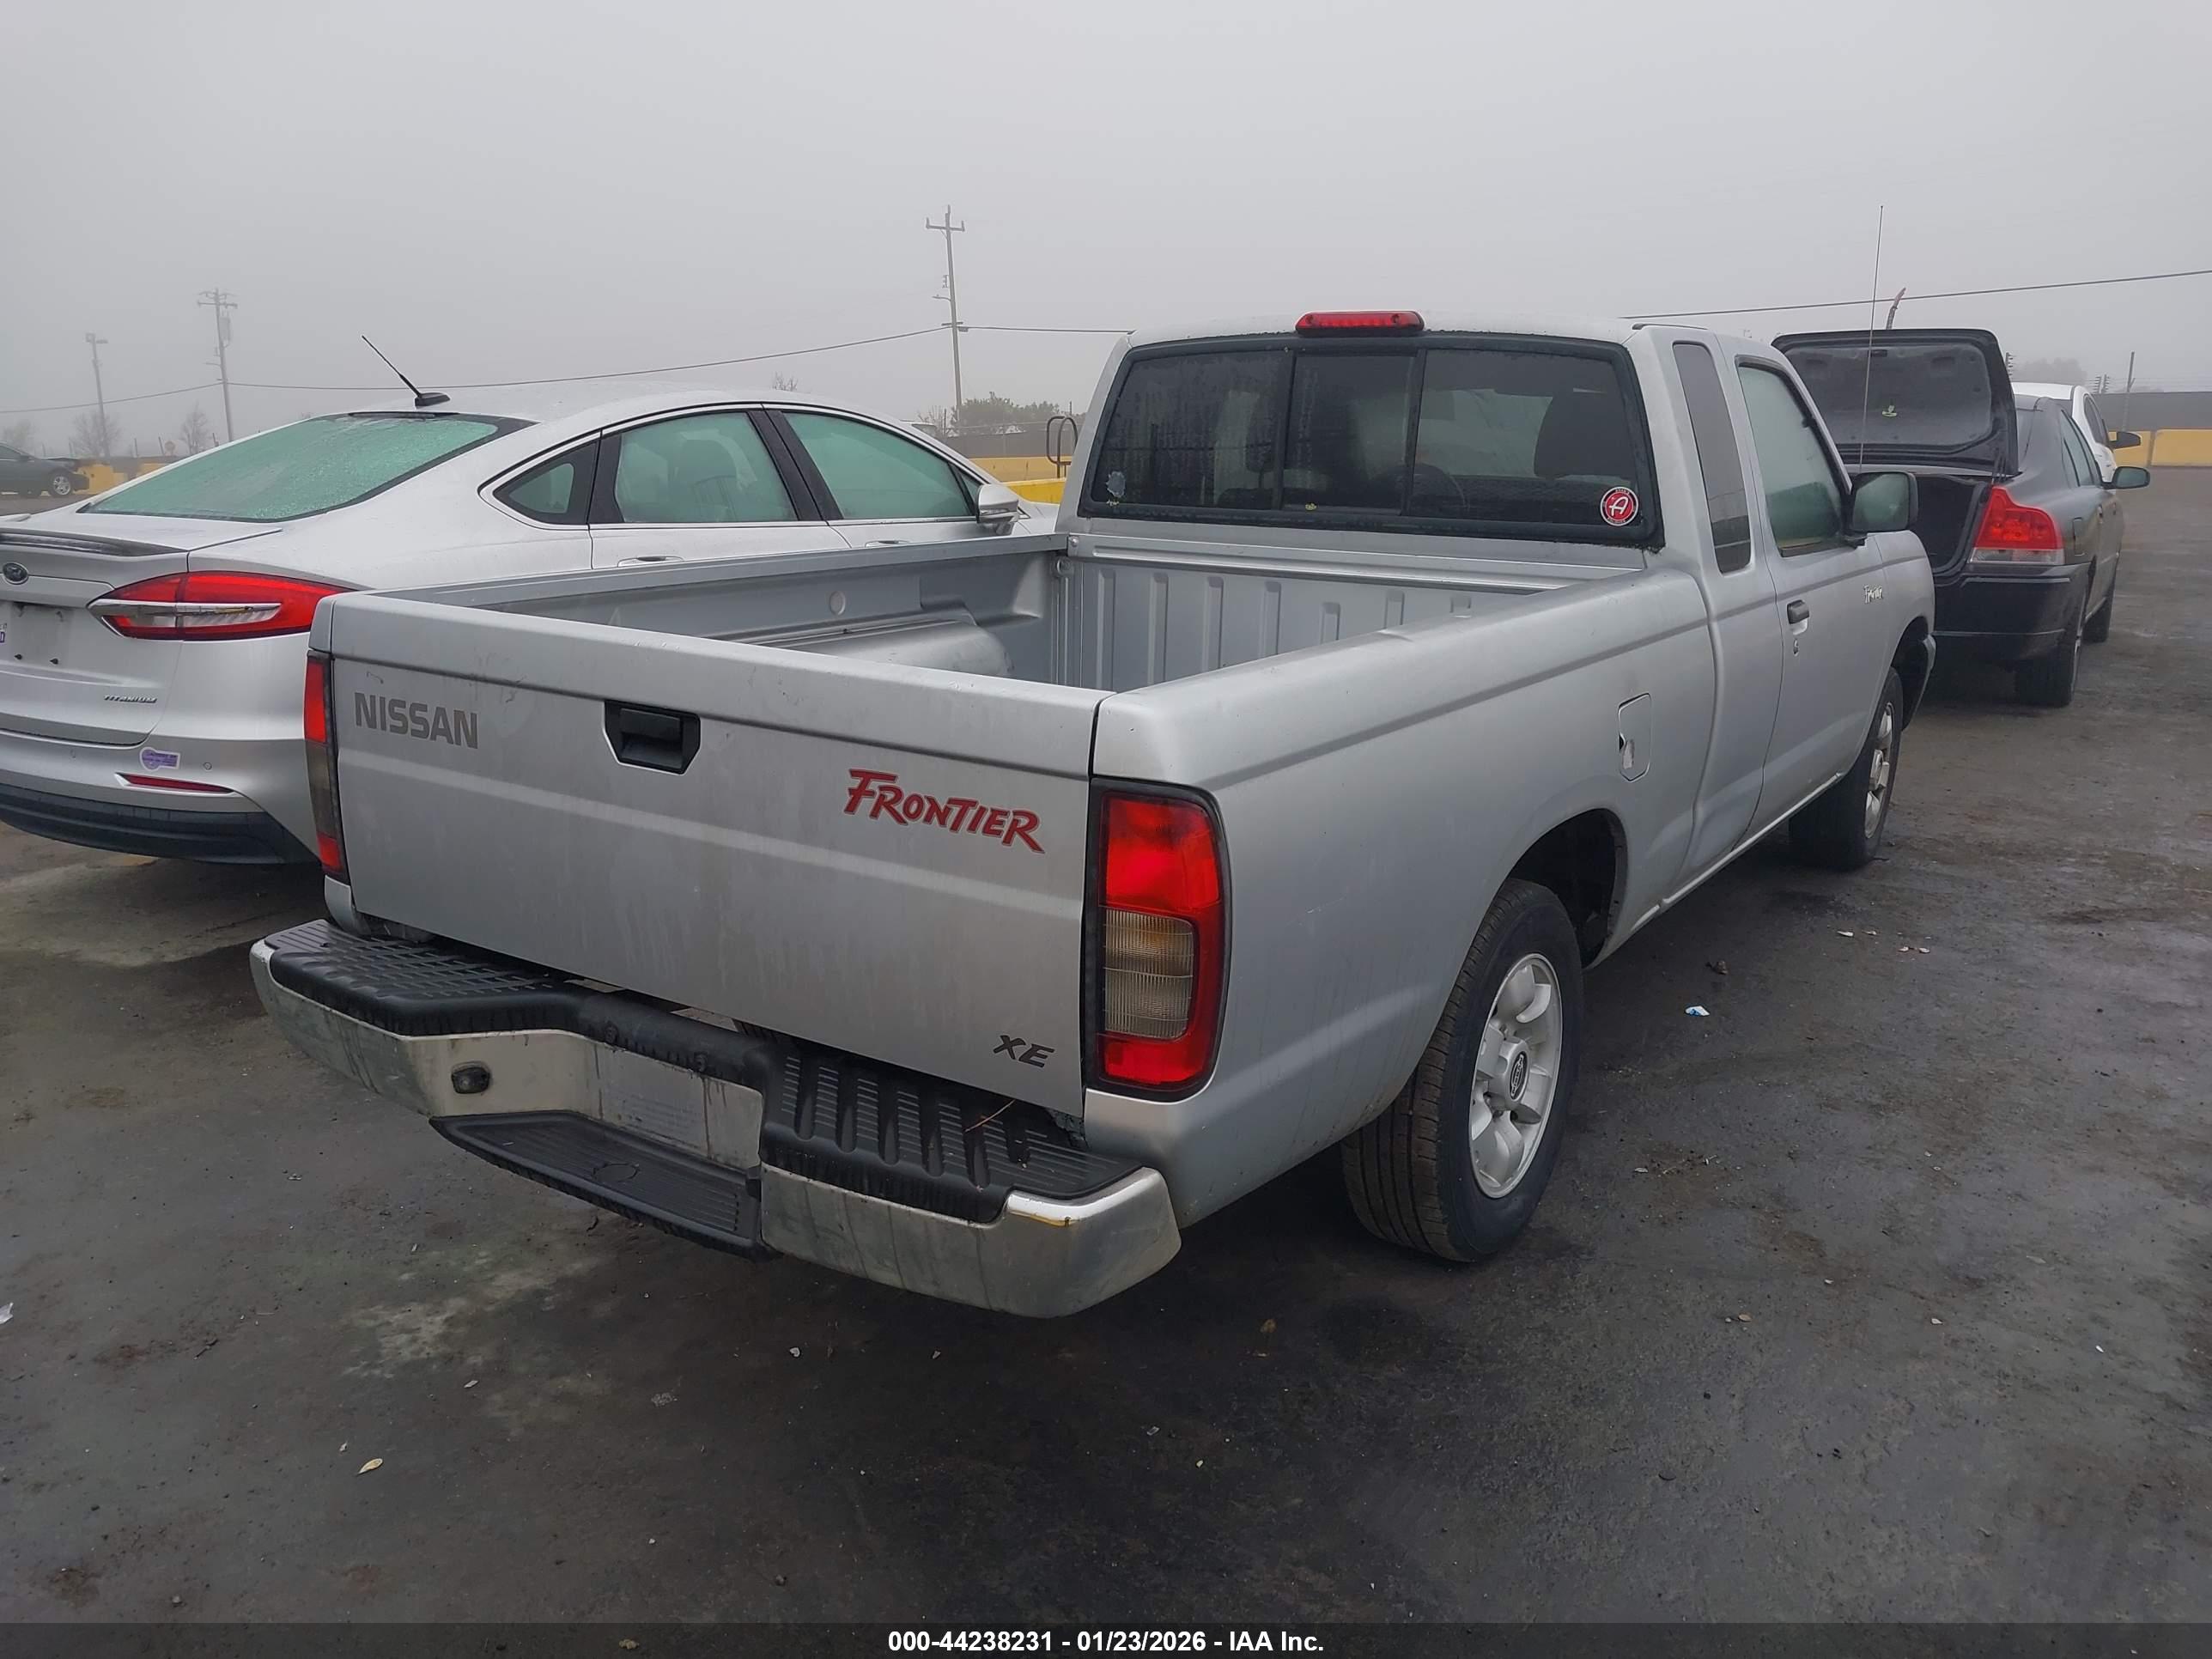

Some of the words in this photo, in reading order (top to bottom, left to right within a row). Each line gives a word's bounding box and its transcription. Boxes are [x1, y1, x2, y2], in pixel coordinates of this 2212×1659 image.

[104, 695, 158, 704] TITANIUM
[354, 691, 479, 750] NISSAN
[843, 768, 1045, 854] FRONTIER
[993, 1035, 1055, 1068] XE
